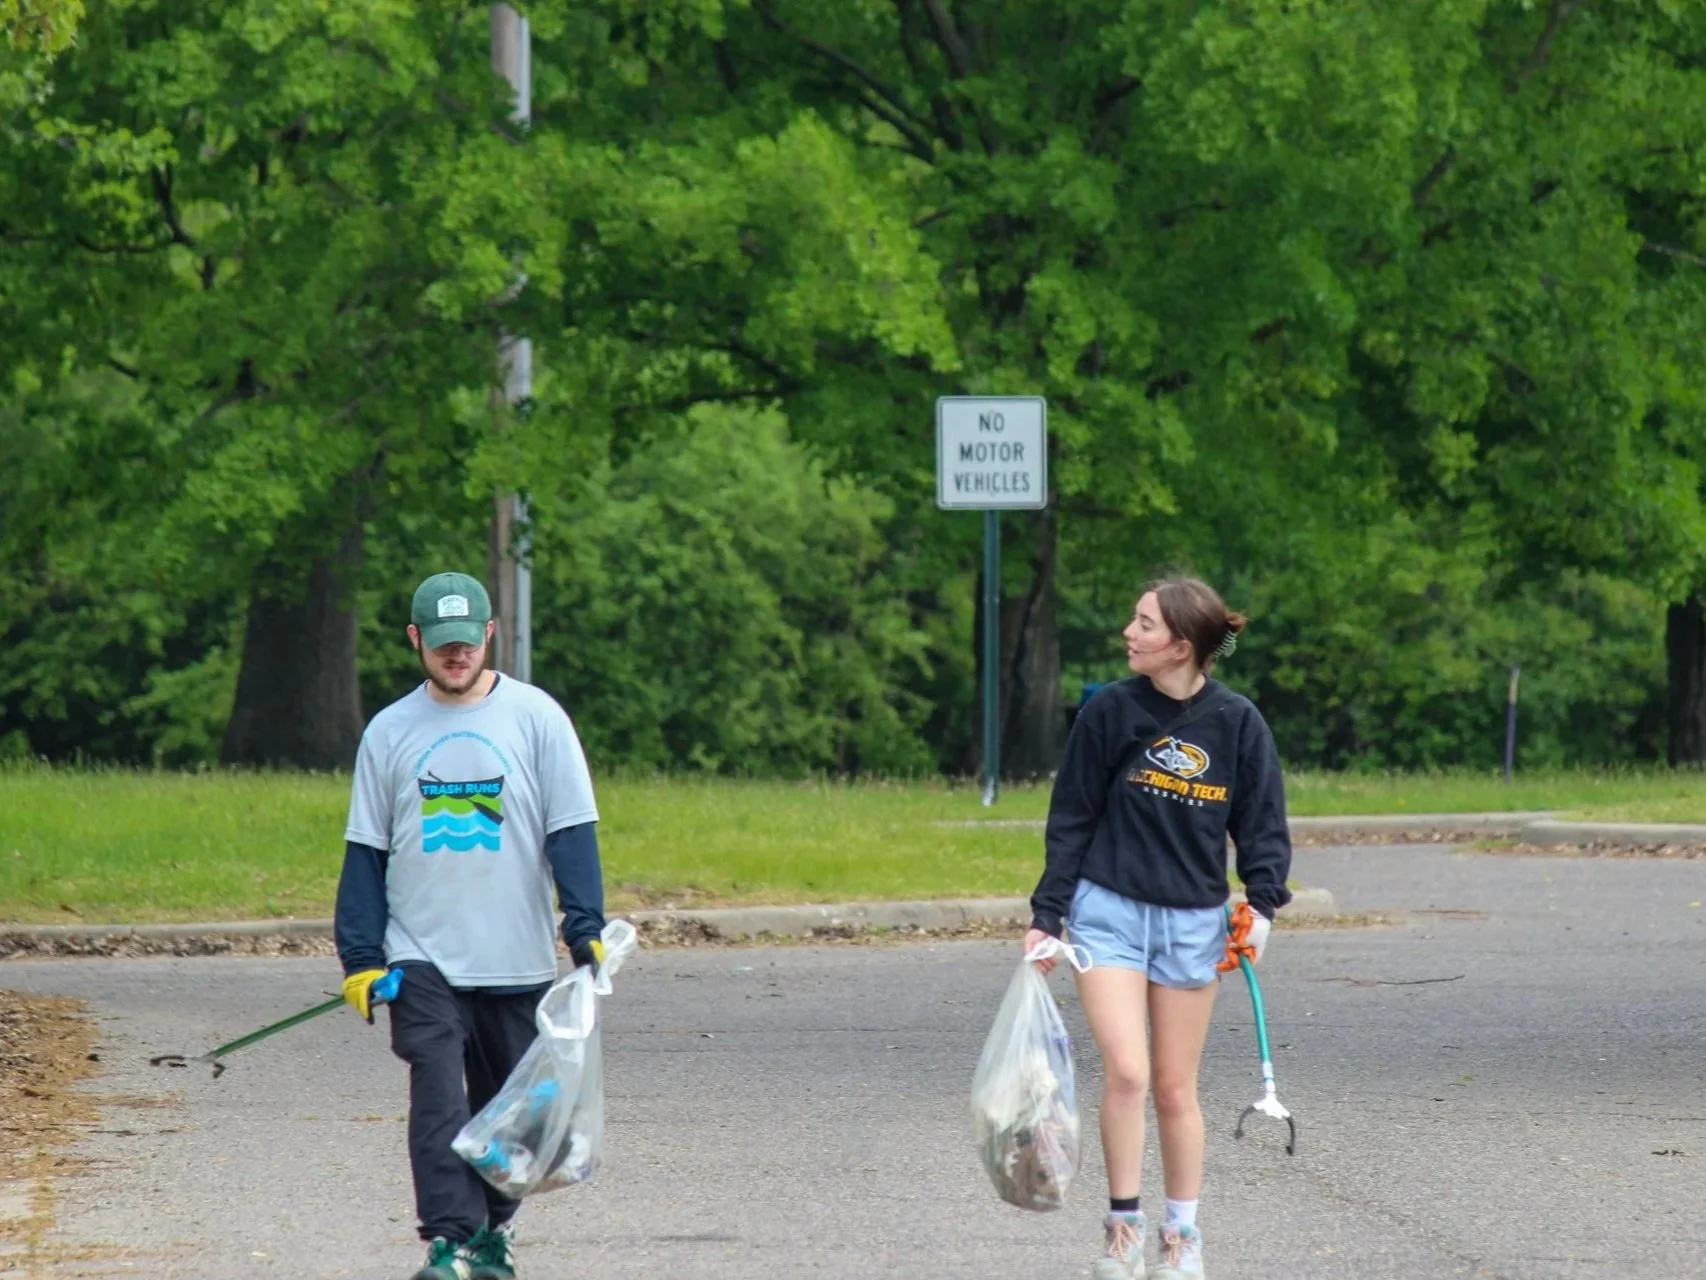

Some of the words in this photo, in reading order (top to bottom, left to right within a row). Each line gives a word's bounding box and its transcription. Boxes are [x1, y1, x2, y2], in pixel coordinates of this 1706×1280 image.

[979, 412, 1005, 433] NO
[959, 442, 1025, 462] MOTOR
[953, 472, 1030, 493] VEHICLES
[421, 783, 463, 796] TRASH
[465, 783, 501, 794] RUNS
